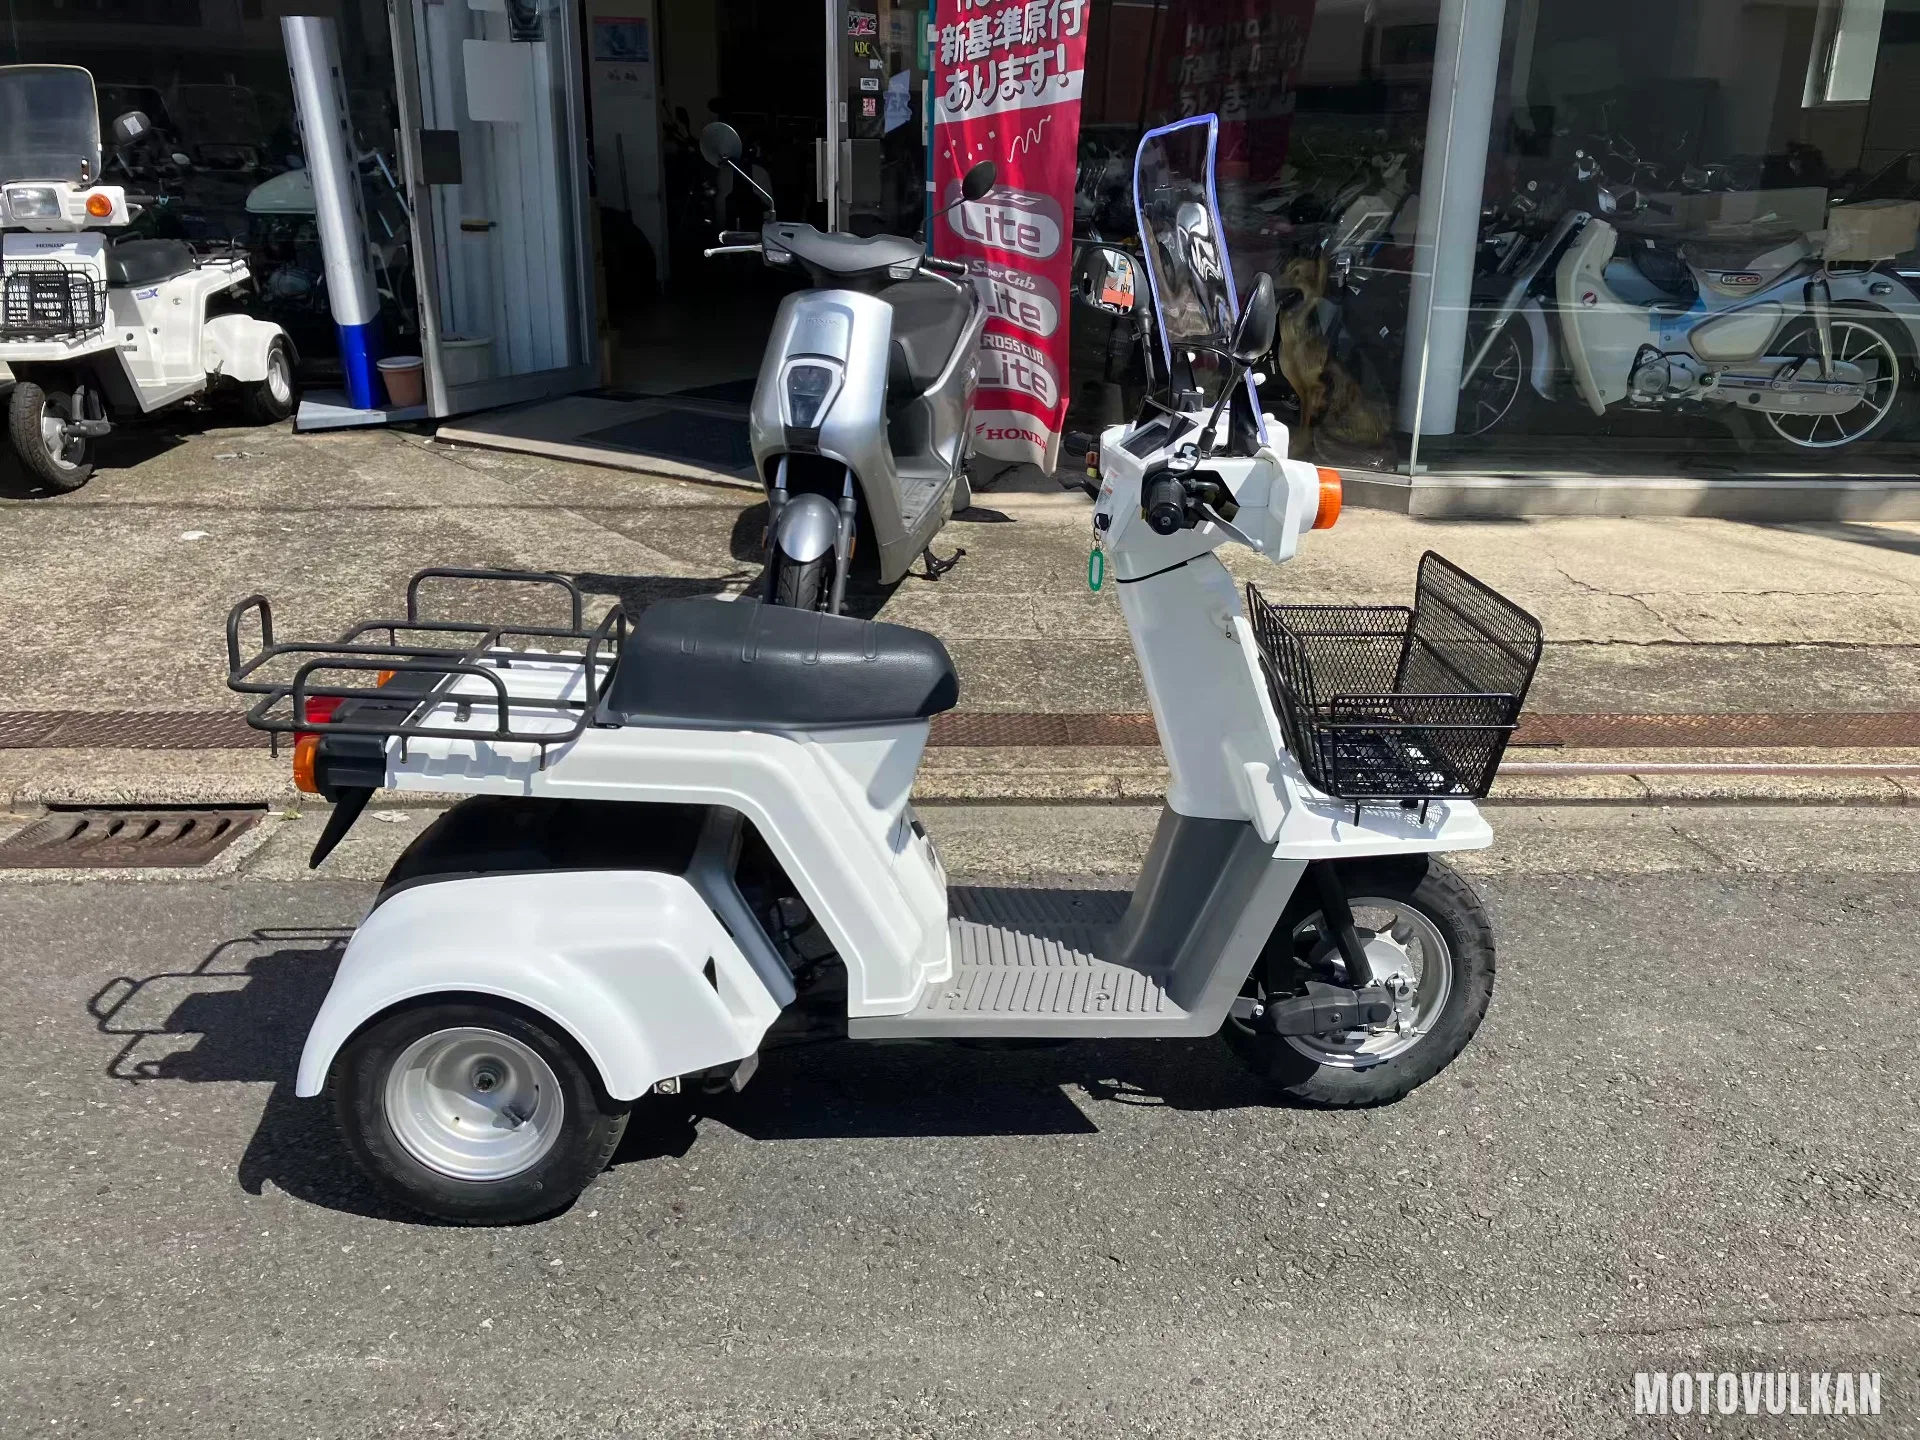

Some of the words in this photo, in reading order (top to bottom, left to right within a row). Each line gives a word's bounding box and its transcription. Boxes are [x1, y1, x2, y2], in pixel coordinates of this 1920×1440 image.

[854, 41, 870, 55] KDC
[940, 0, 1085, 66] 新基準原付
[961, 203, 1041, 253] Lite
[1004, 270, 1036, 290] Cub
[986, 283, 1041, 333] ite
[981, 333, 1020, 354] ROSS
[1021, 343, 1045, 367] CUB
[986, 427, 1048, 455] HONDA
